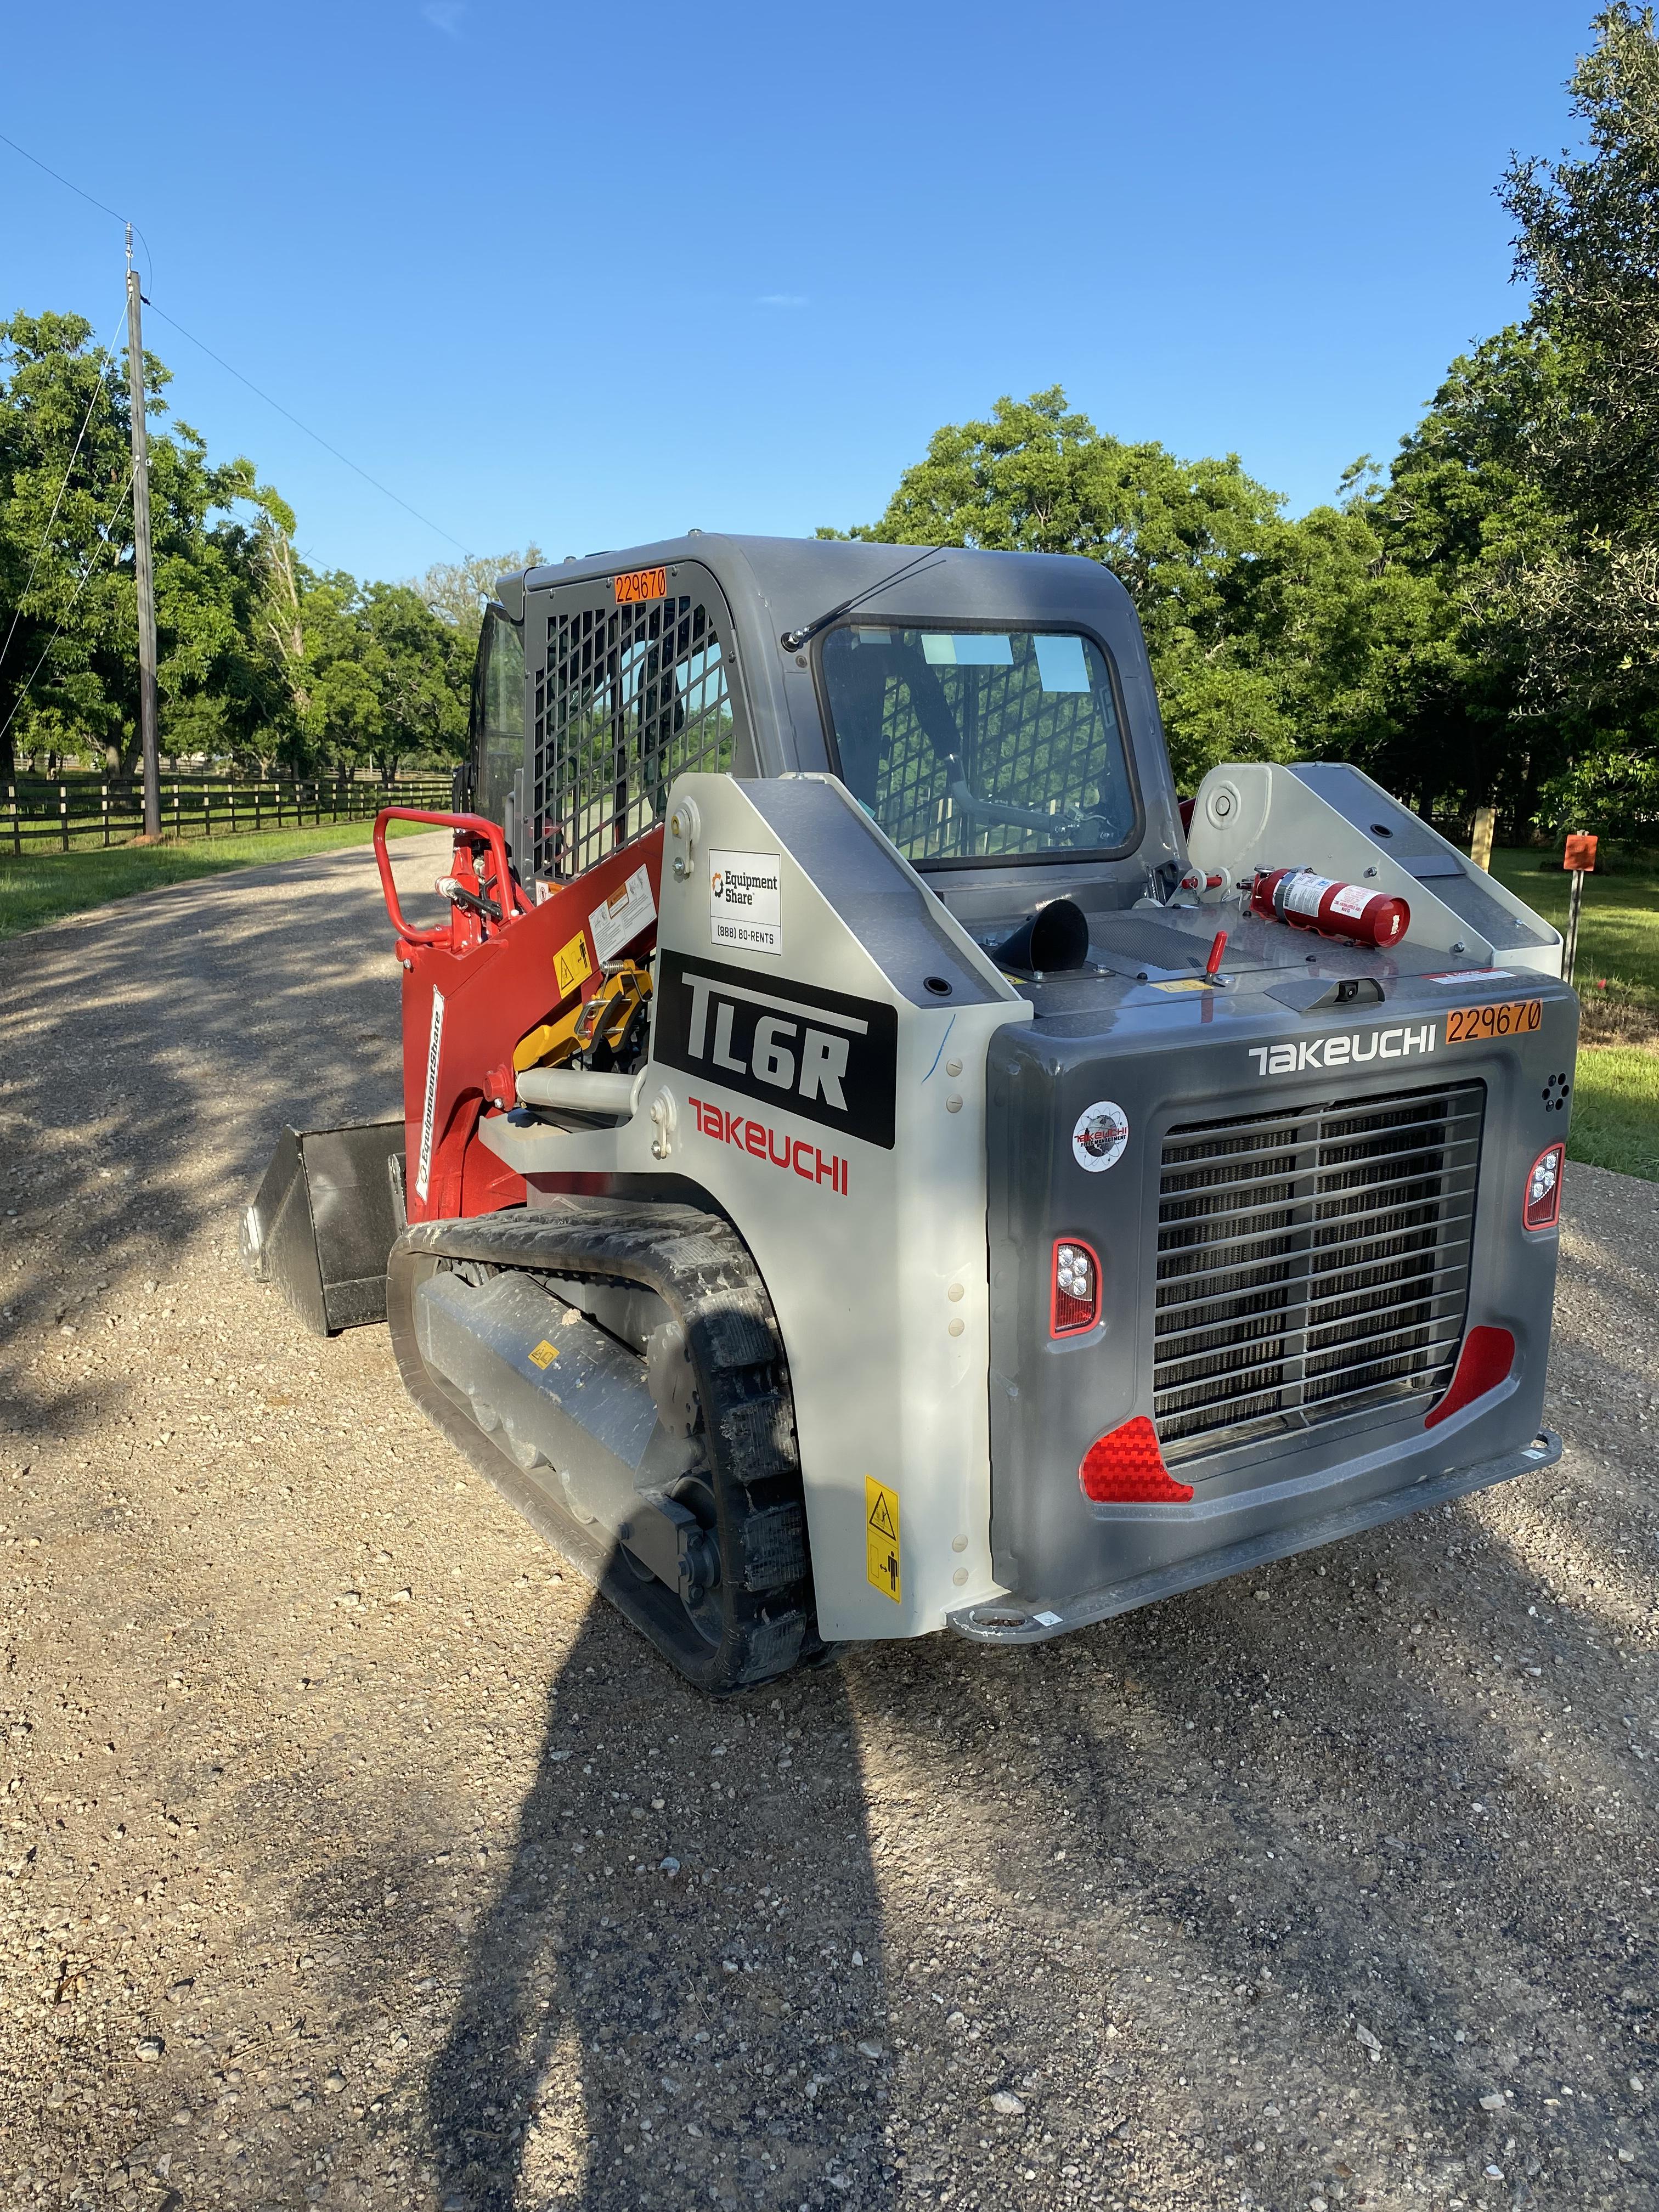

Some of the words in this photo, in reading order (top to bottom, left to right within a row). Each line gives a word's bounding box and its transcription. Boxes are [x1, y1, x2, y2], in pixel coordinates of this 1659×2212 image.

[616, 568, 665, 602] 229670
[725, 871, 777, 890] Equipment
[725, 888, 753, 905] Share
[718, 925, 736, 939] (888)
[738, 929, 774, 944] 80-RENTS
[1448, 999, 1542, 1042] 229670
[682, 972, 868, 1111] TL6R
[421, 1011, 440, 1164] EquipmentShare
